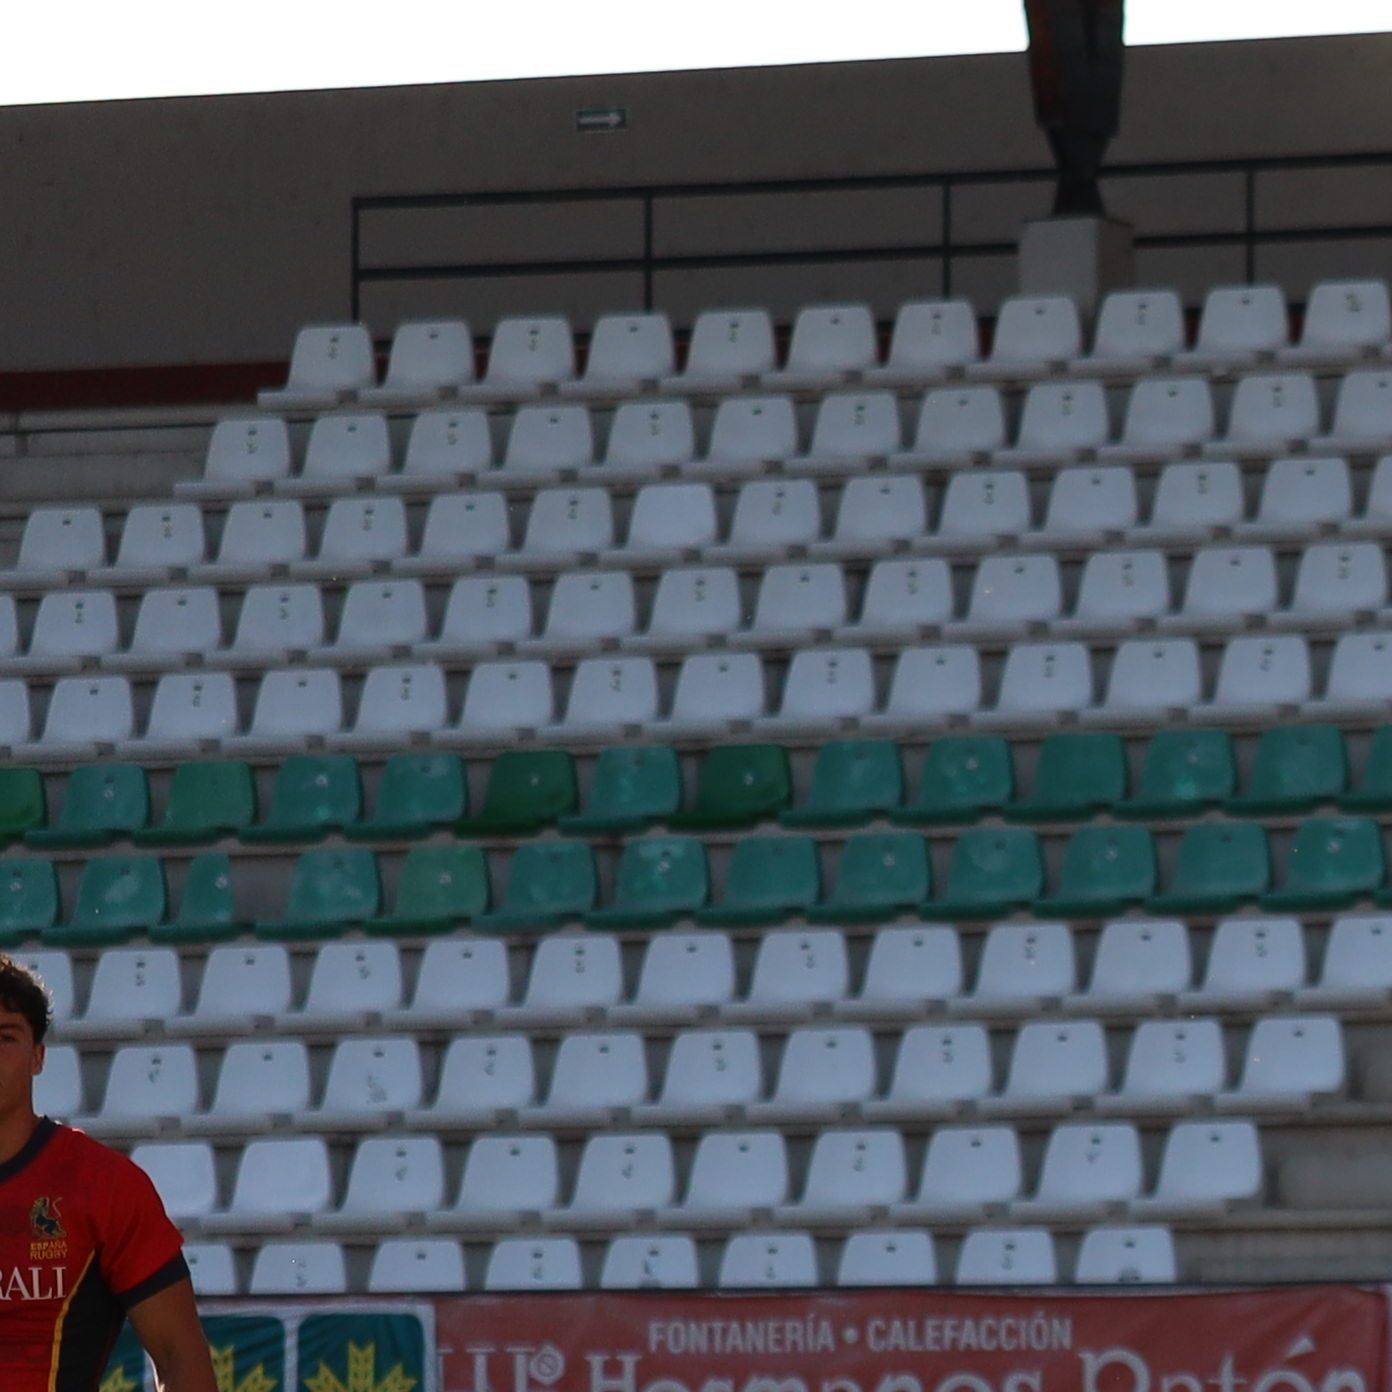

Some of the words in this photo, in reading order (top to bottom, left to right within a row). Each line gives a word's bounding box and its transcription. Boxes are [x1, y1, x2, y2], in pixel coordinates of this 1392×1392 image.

[30, 1250, 67, 1261] RUGBY
[649, 1315, 836, 1354] FONTANERÍA
[866, 1311, 1073, 1353] CALEFACCIÓN
